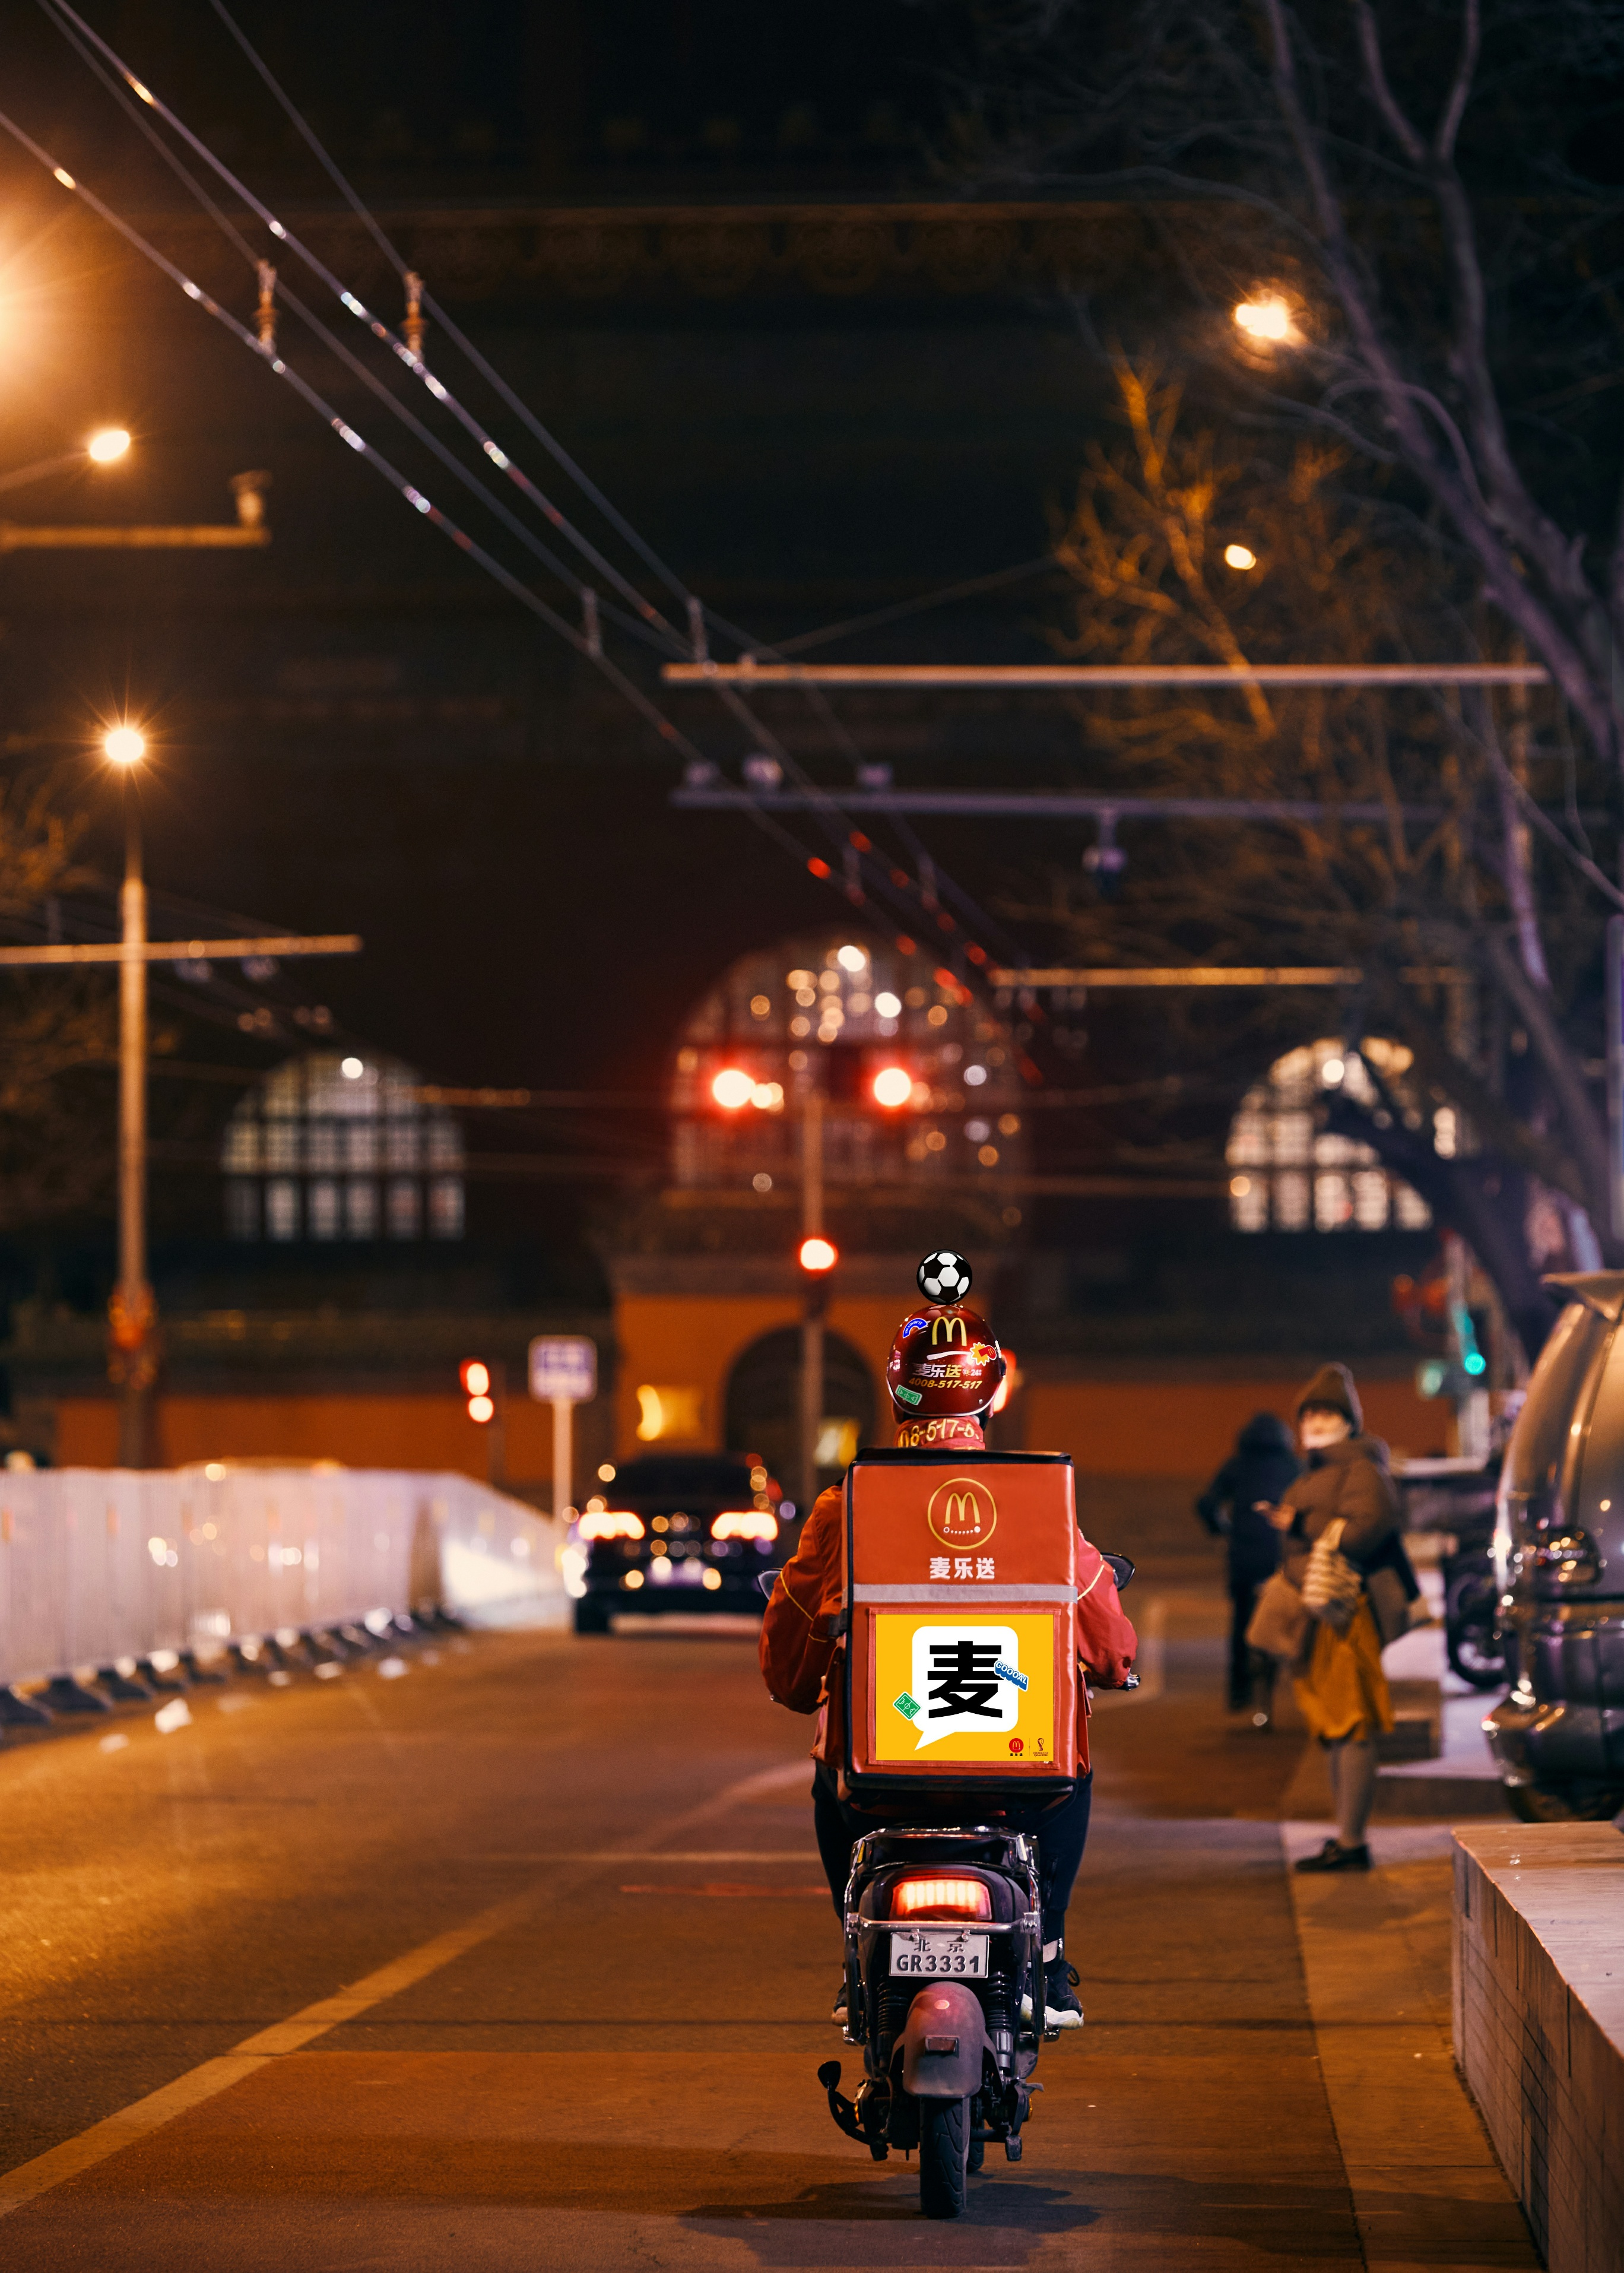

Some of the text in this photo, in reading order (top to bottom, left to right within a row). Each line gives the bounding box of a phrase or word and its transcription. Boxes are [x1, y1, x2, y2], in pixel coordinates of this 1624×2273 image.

[913, 1363, 962, 1377] 麦乐送
[909, 1377, 983, 1389] 4008-517-517
[930, 1556, 995, 1580] 麦乐送
[927, 1640, 1003, 1719] 麦
[995, 1661, 1027, 1686] GOOOAL
[914, 1939, 969, 1952] 北京
[896, 1954, 979, 1973] GR3331
